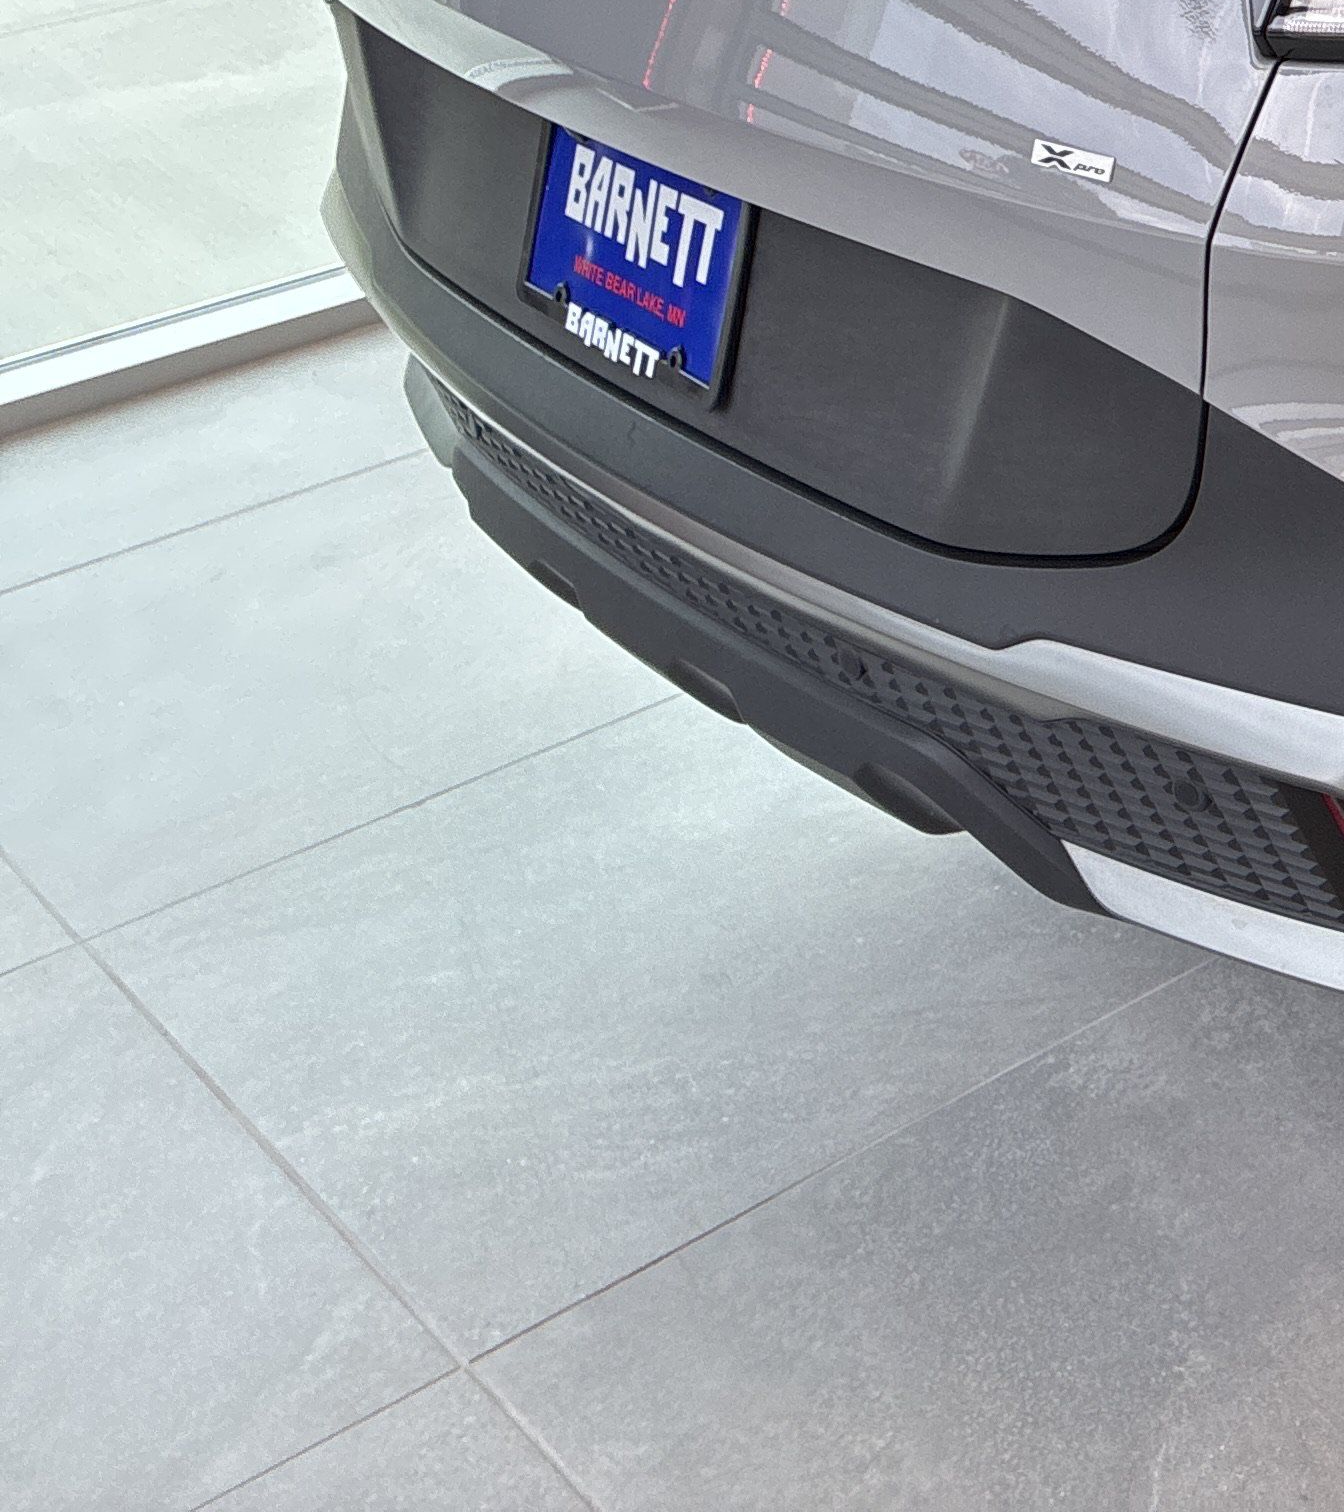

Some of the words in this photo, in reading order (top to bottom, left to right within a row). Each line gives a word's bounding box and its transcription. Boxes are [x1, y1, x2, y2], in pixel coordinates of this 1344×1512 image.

[564, 143, 724, 288] BARNETT
[574, 254, 605, 286] WHITE
[605, 271, 636, 302] BEAR
[667, 303, 686, 328] MN
[564, 301, 660, 378] BARNETT
